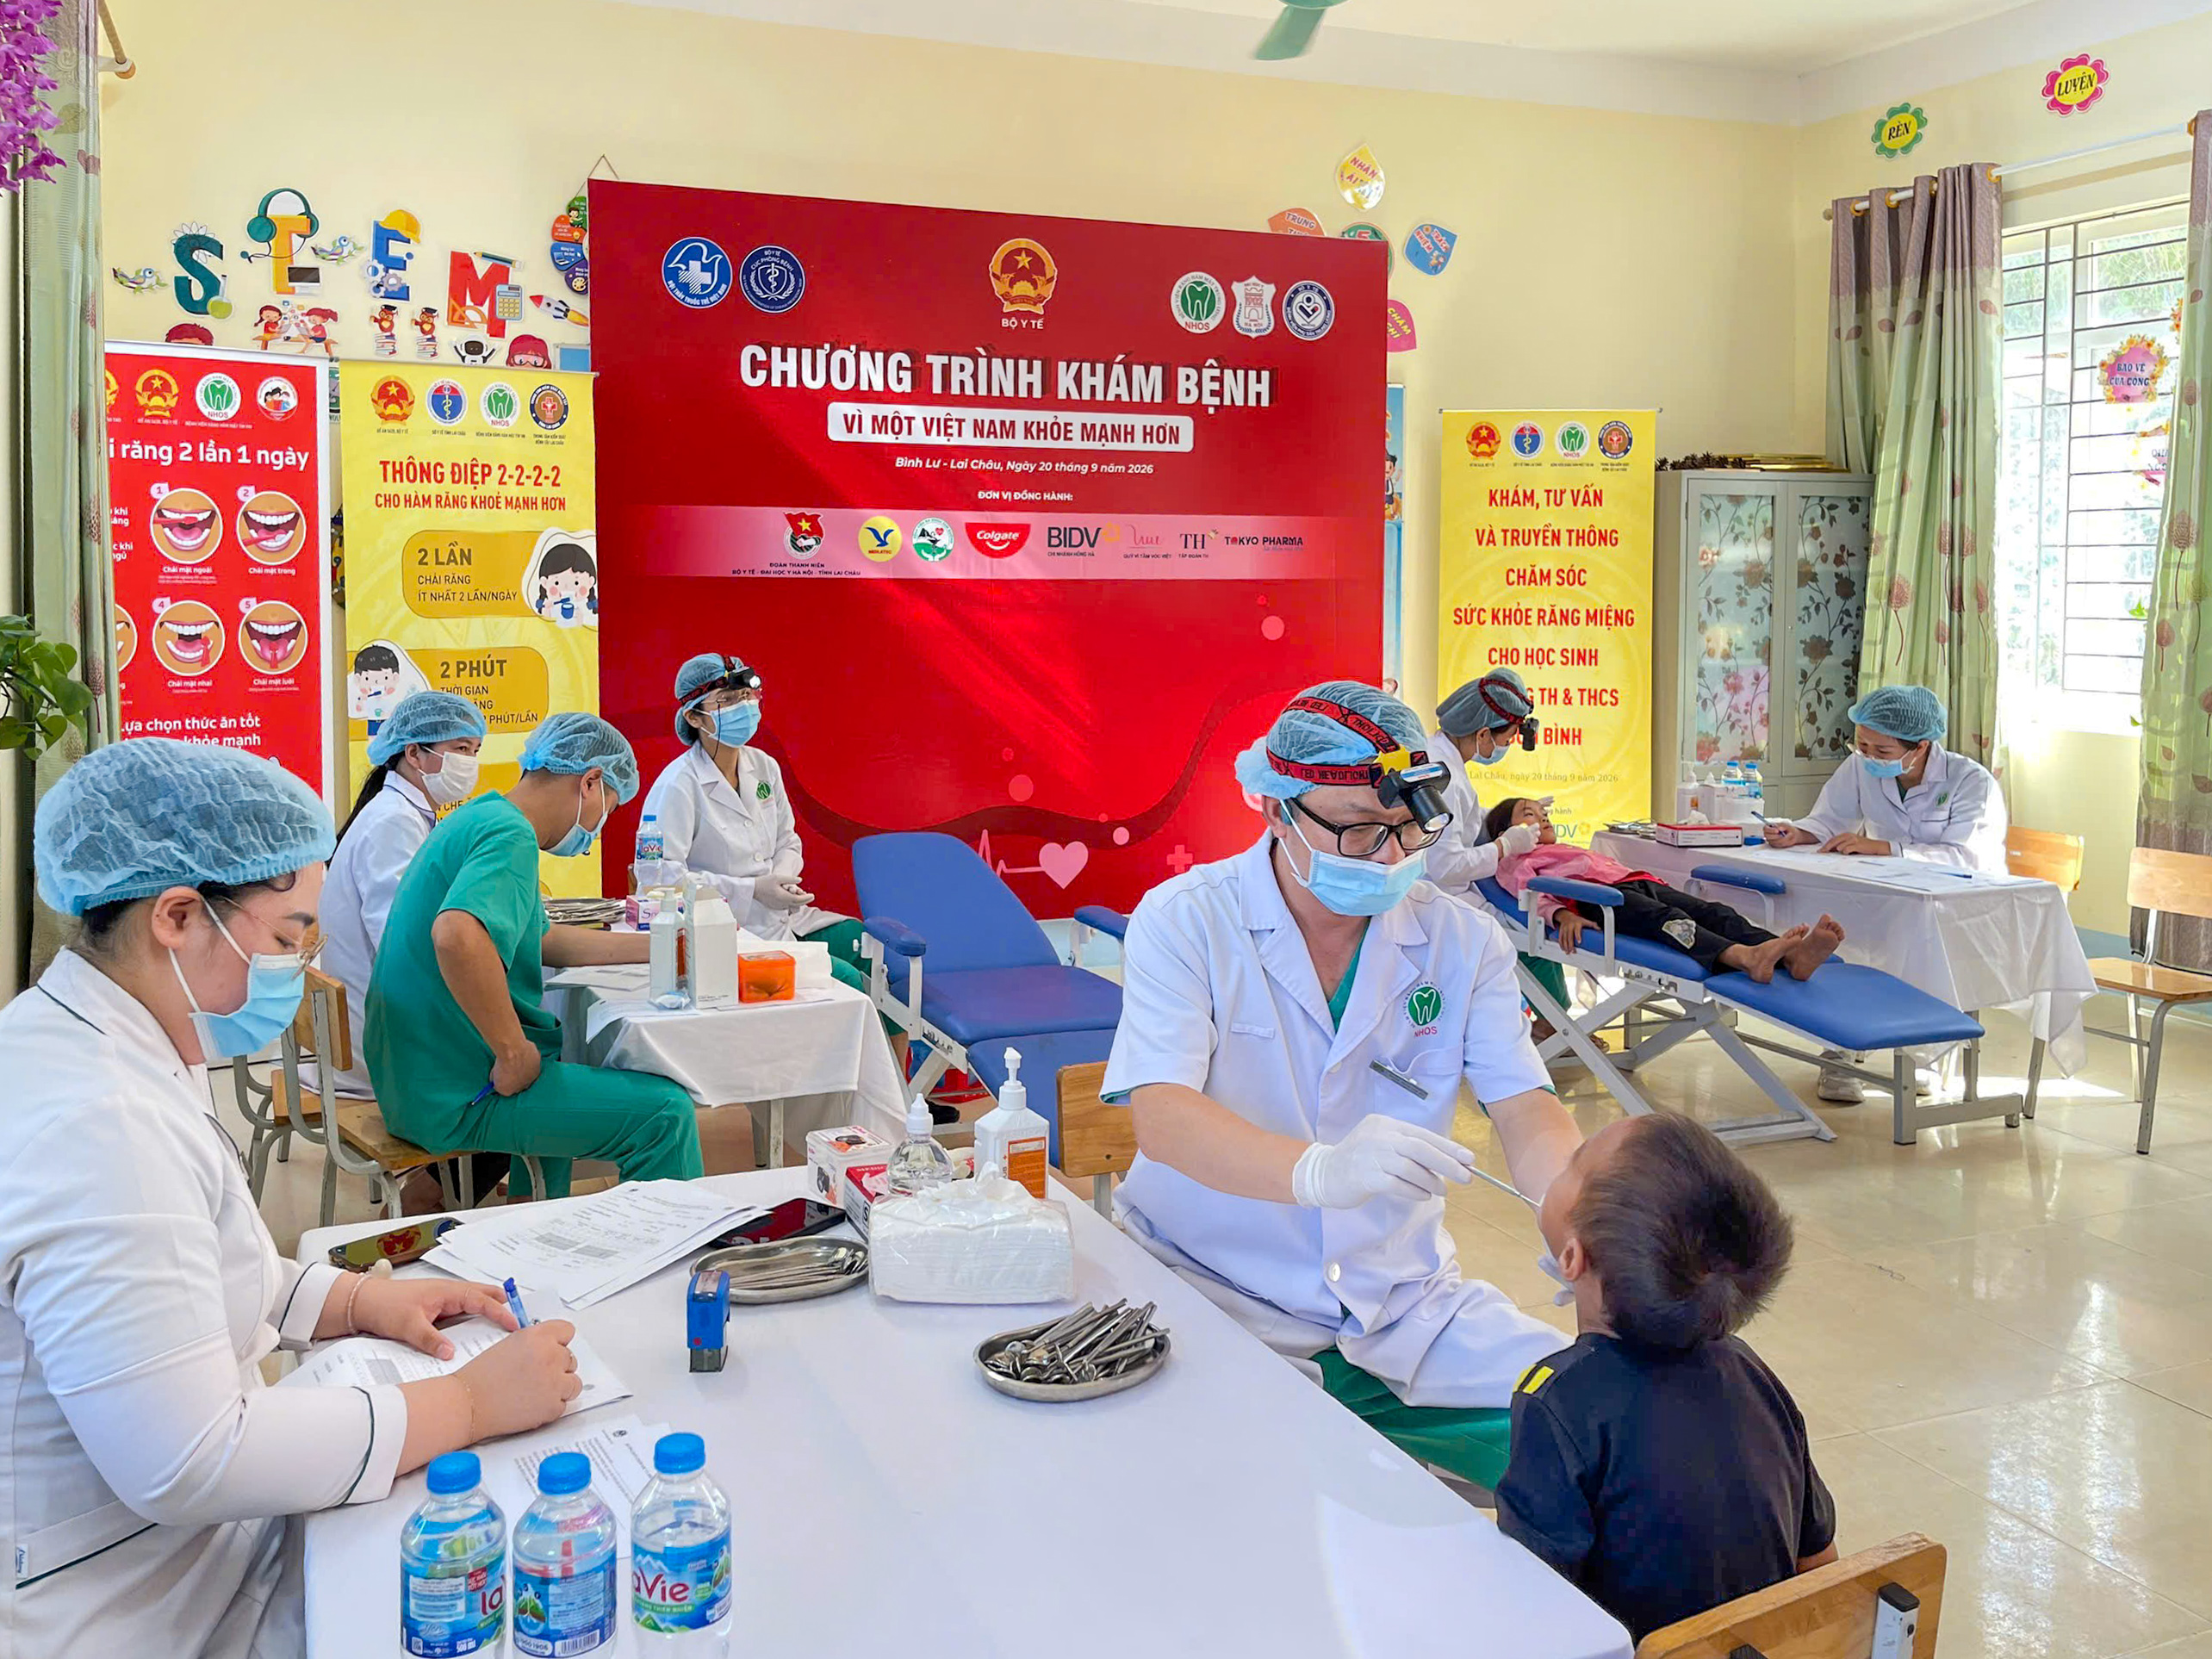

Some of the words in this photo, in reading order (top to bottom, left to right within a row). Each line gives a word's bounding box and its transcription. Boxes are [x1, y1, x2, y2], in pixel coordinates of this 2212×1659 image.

[2056, 71, 2097, 97] LUYỆN
[1887, 121, 1912, 141] RÈN
[1285, 212, 1316, 230] TRUNG
[1001, 318, 1017, 329] BỘ
[1020, 319, 1028, 329] Y
[1030, 317, 1044, 329] TẾ
[1184, 321, 1210, 331] NHOS
[739, 344, 913, 394] CHƯƠNG
[926, 346, 1043, 399] TRÌNH
[1057, 353, 1164, 405] KHÁM
[1177, 358, 1271, 415] BỆNH
[843, 407, 865, 434] VÌ
[871, 411, 916, 443] MỘT
[923, 413, 966, 444] VIỆT
[972, 418, 1016, 439] NAM
[1023, 414, 1074, 443] KHỎE
[1081, 419, 1135, 449] MẠNH
[1142, 419, 1181, 446] HƠN
[121, 440, 173, 466] răng
[179, 442, 193, 461] 2
[199, 438, 232, 463] lần
[237, 445, 252, 463] 1
[257, 444, 309, 471] ngày
[379, 456, 445, 485] THÔNG
[450, 457, 493, 489] ĐIỆP
[498, 464, 562, 488] 2-2-2-2
[896, 456, 923, 470] Bình
[925, 457, 941, 470] Lư
[950, 458, 969, 471] Lai
[971, 458, 1004, 474] Châu,
[1006, 460, 1036, 475] Ngày
[1038, 462, 1053, 472] 20
[1055, 461, 1089, 475] tháng
[1090, 463, 1097, 473] 9
[1101, 463, 1125, 474] năm
[1127, 464, 1155, 475] 2026
[243, 488, 250, 497] 2
[375, 493, 401, 508] CHO
[403, 490, 432, 510] HÀM
[434, 490, 469, 510] RĂNG
[504, 495, 539, 513] MẠNH
[541, 495, 567, 512] HƠN
[978, 489, 1000, 500] ĐƠN
[1002, 490, 1011, 502] VỊ
[1013, 488, 1042, 501] ĐỒNG
[1043, 490, 1073, 502] HÀNH:
[1488, 484, 1539, 511] KHÁM,
[1544, 488, 1567, 507] TƯ
[1570, 482, 1604, 507] VẤN
[976, 529, 1021, 544] Colgate
[1047, 526, 1102, 549] BIDV
[1179, 533, 1206, 550] TH
[1262, 537, 1304, 546] PHARMA
[1475, 524, 1497, 547] VÀ
[1501, 522, 1561, 547] TRUYỀN
[1565, 524, 1619, 547] THÔNG
[418, 548, 429, 566] 2
[435, 541, 472, 567] LẦN
[418, 572, 441, 585] CHẢI
[444, 570, 471, 585] RĂNG
[1506, 563, 1551, 587] CHĂM
[1556, 564, 1588, 587] SÓC
[158, 600, 165, 609] 4
[245, 600, 251, 609] 5
[418, 588, 428, 602] ÍT
[431, 588, 457, 602] NHẤT
[459, 592, 465, 602] 2
[1453, 603, 1487, 626] SỨC
[1491, 601, 1532, 627] KHỎE
[1537, 604, 1581, 627] RĂNG
[1586, 604, 1636, 631] MIỆNG
[440, 661, 451, 679] 2
[456, 653, 507, 679] PHÚT
[1488, 647, 1520, 666] CHO
[1525, 648, 1556, 670] HỌC
[1560, 648, 1599, 667] SINH
[465, 686, 489, 696] GIAN
[1538, 688, 1557, 706] TH
[1563, 688, 1574, 706] &
[1578, 687, 1619, 707] THCS
[474, 697, 494, 710] ĂNG
[121, 719, 142, 735] ựa
[146, 718, 182, 734] chọn
[184, 716, 216, 730] thức
[220, 717, 237, 729] ăn
[239, 711, 261, 728] tốt
[489, 709, 538, 724] PHÚT/LẦN
[1544, 723, 1581, 746] BÌNH
[1552, 823, 1578, 839] IDV
